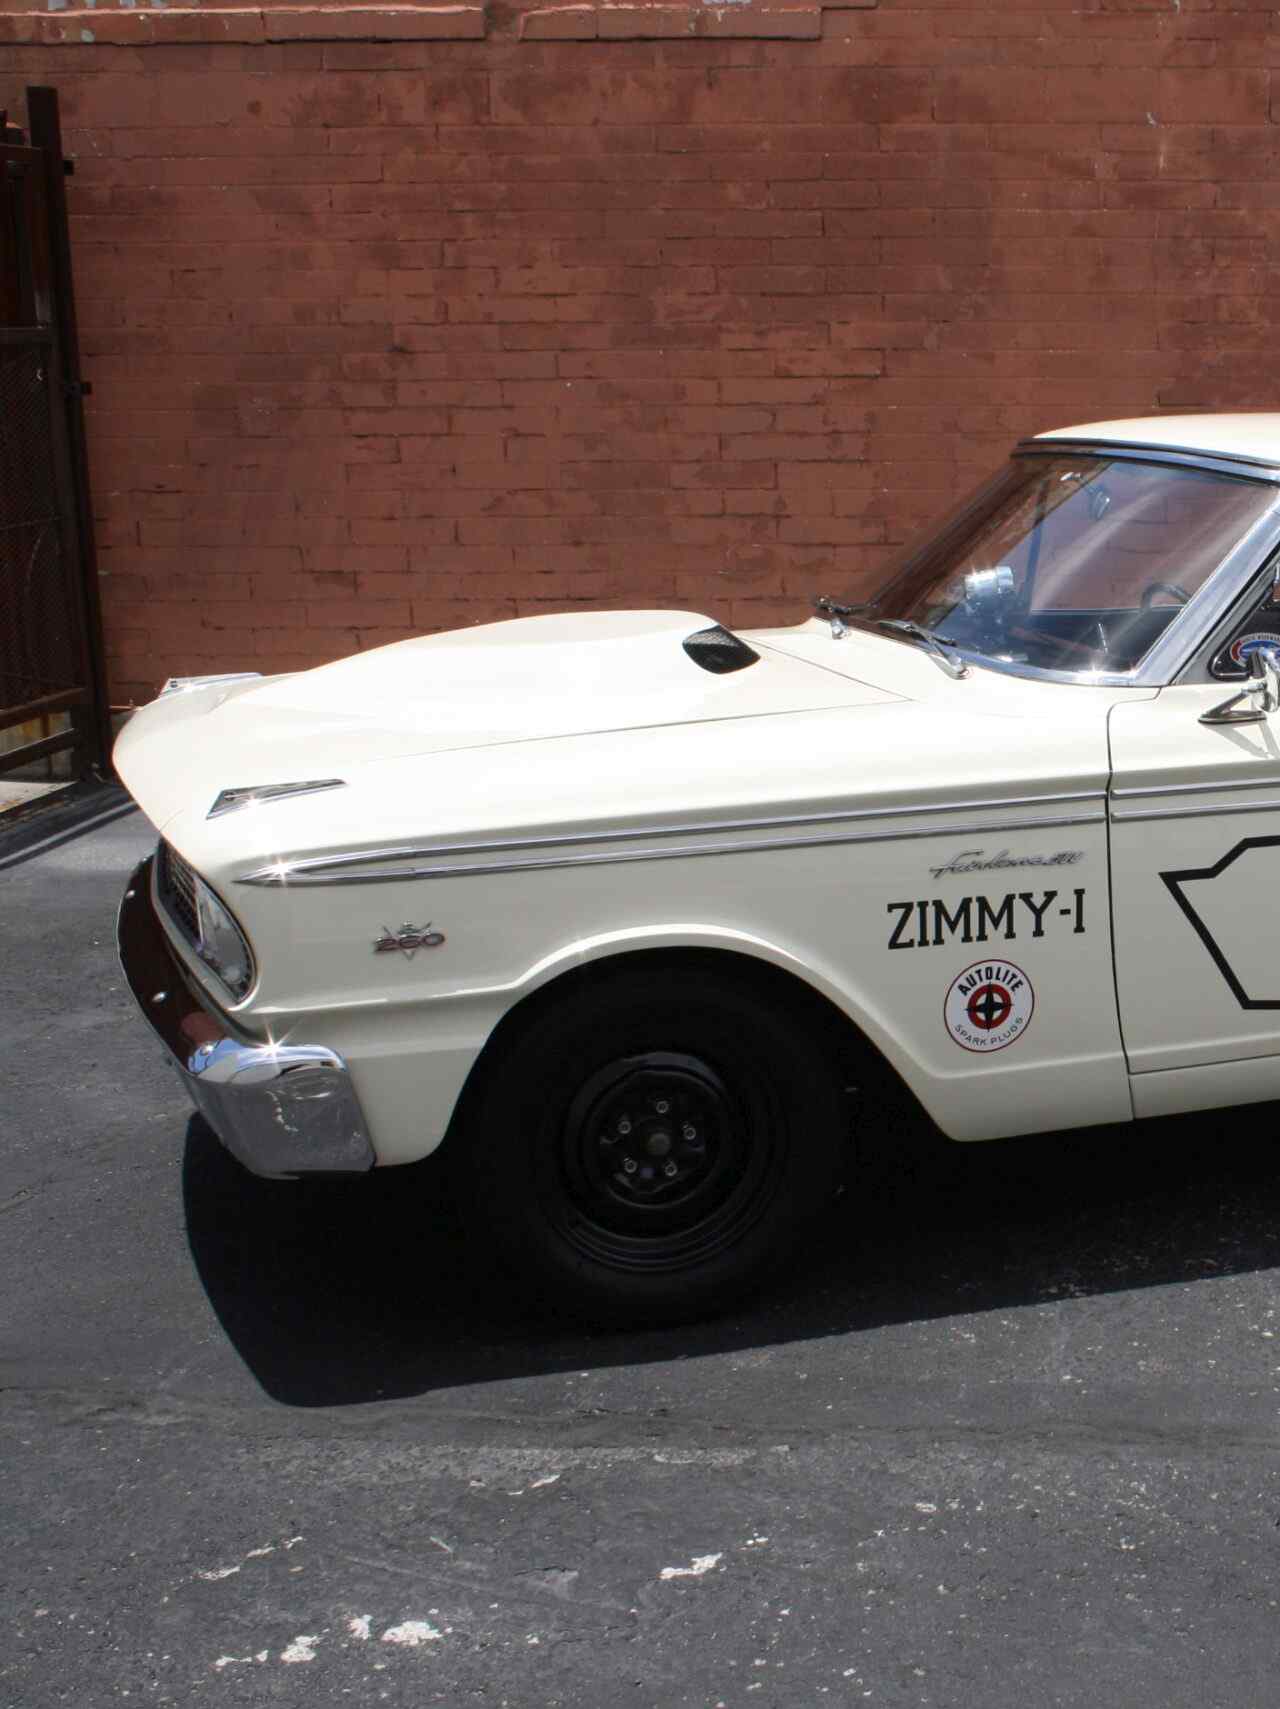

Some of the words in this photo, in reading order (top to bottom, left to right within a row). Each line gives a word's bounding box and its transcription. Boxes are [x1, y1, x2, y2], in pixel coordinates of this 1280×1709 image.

[887, 888, 1086, 950] ZIMMY-I
[374, 931, 445, 952] 260
[957, 966, 1024, 996] AUTOLITE
[954, 1024, 987, 1046] SPARK
[990, 1016, 1023, 1045] PLUGS
